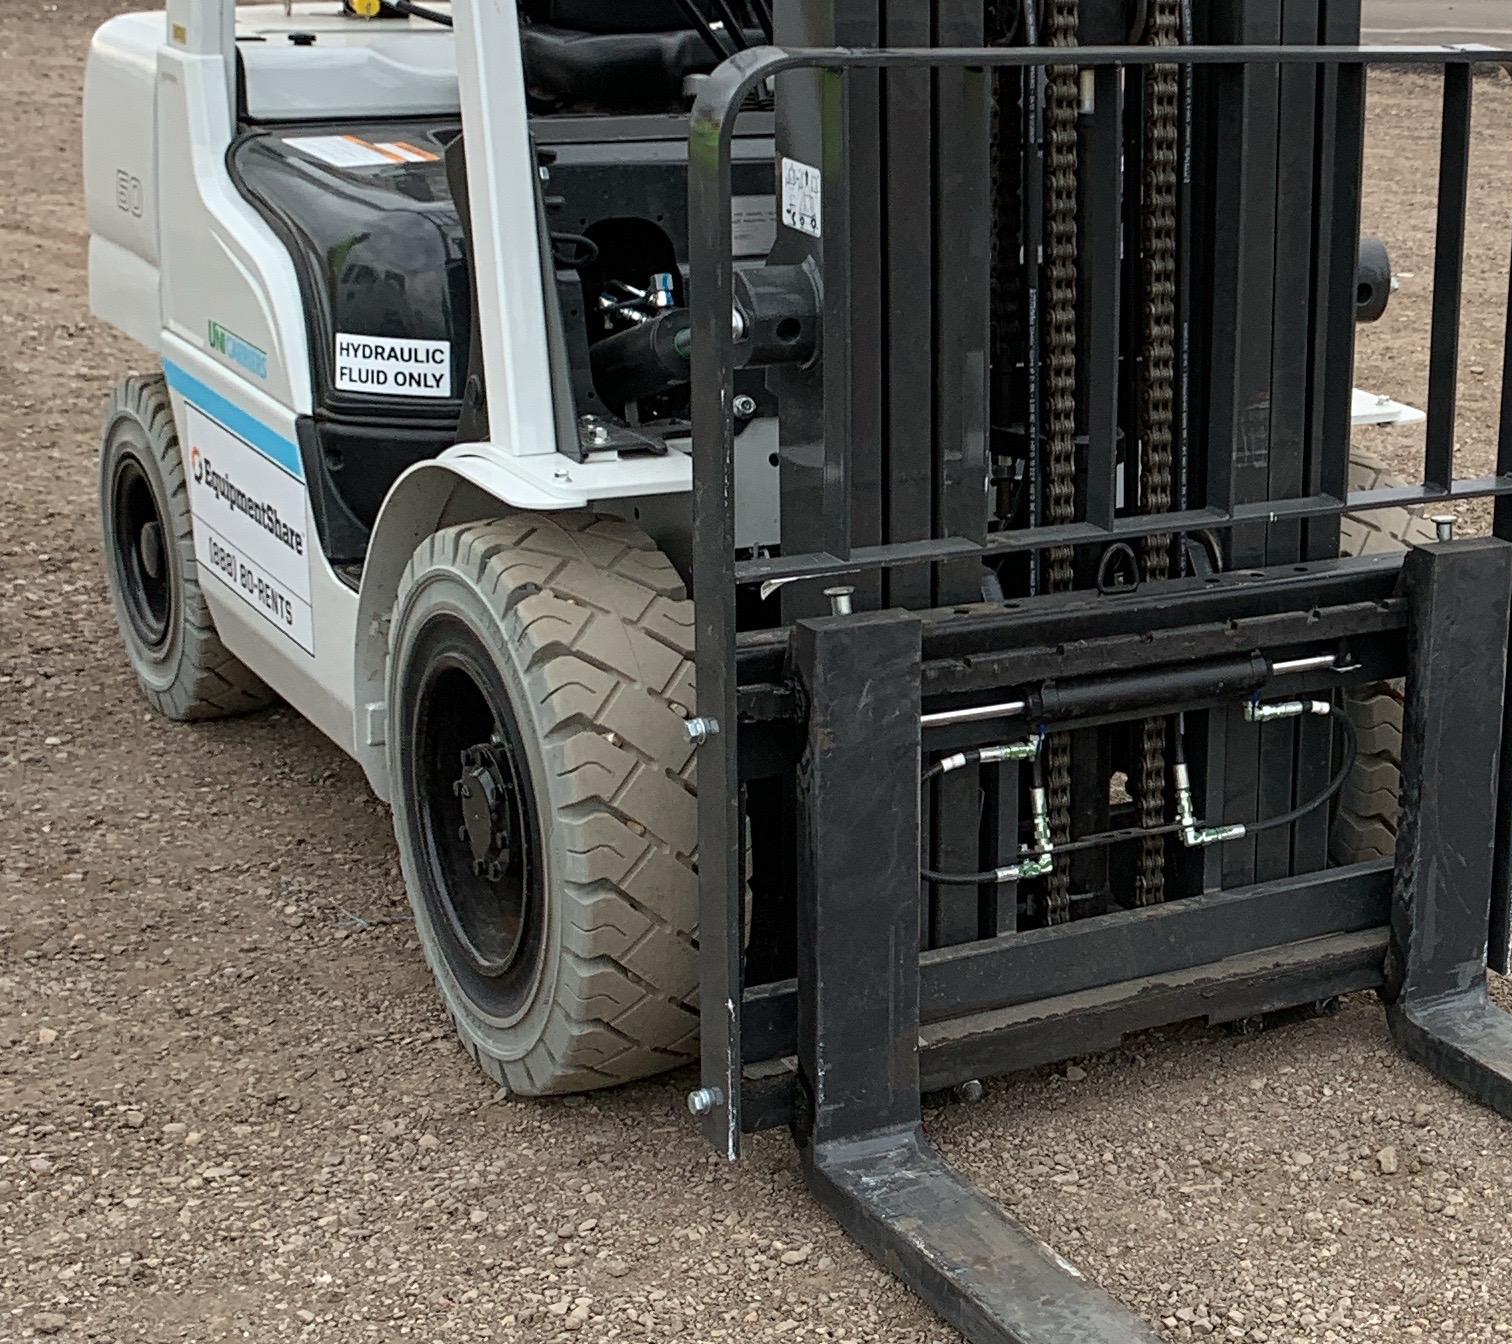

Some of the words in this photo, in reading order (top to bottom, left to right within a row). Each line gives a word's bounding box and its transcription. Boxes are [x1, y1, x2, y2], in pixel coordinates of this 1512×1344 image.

[339, 341, 445, 365] HYDRAULIC
[340, 365, 388, 386] FLUID
[393, 371, 445, 389] ONLY
[204, 457, 304, 557] EquipmentShare
[239, 562, 294, 627] 80-RENTS
